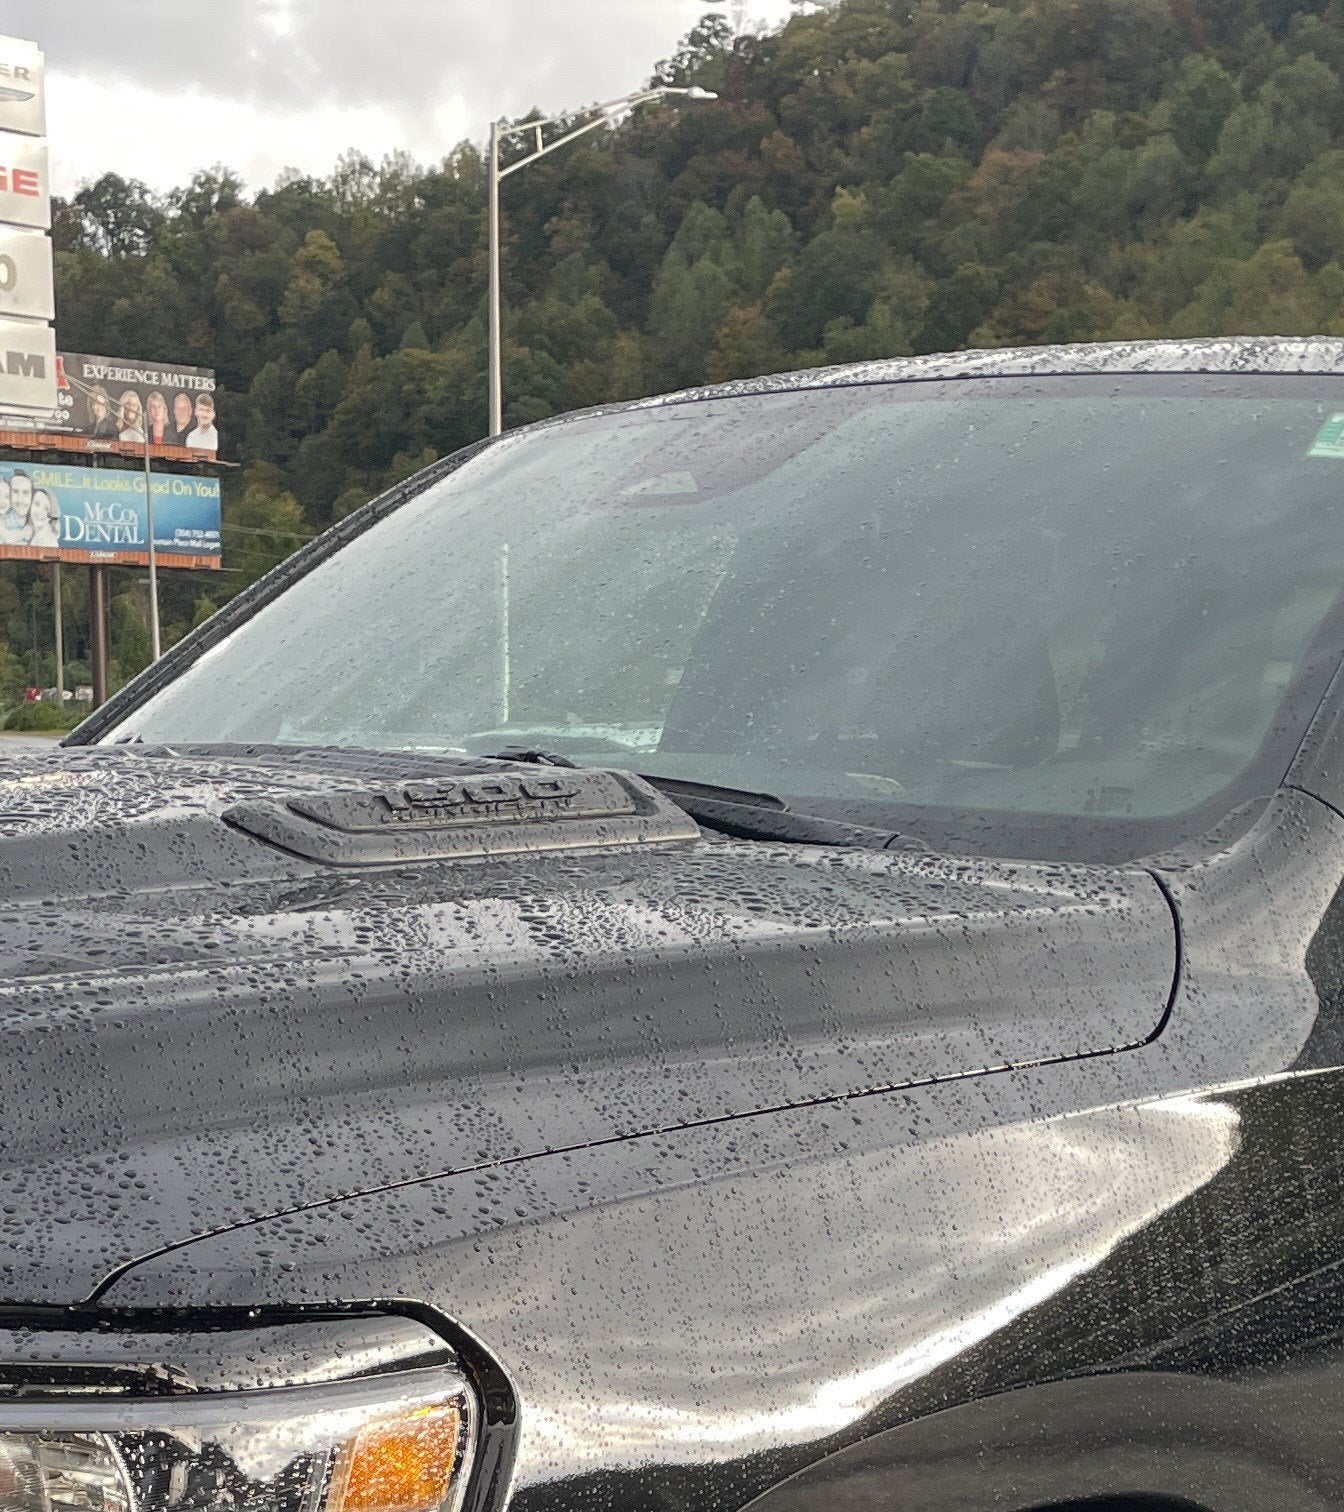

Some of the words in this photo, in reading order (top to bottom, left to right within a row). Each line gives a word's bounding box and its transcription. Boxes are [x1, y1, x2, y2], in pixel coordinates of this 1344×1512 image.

[82, 363, 160, 385] EXPERIENCE
[160, 372, 216, 392] MATTERS
[172, 479, 193, 495] On
[193, 481, 221, 498] You!
[63, 515, 145, 545] DENTAL
[372, 777, 582, 814] 1500
